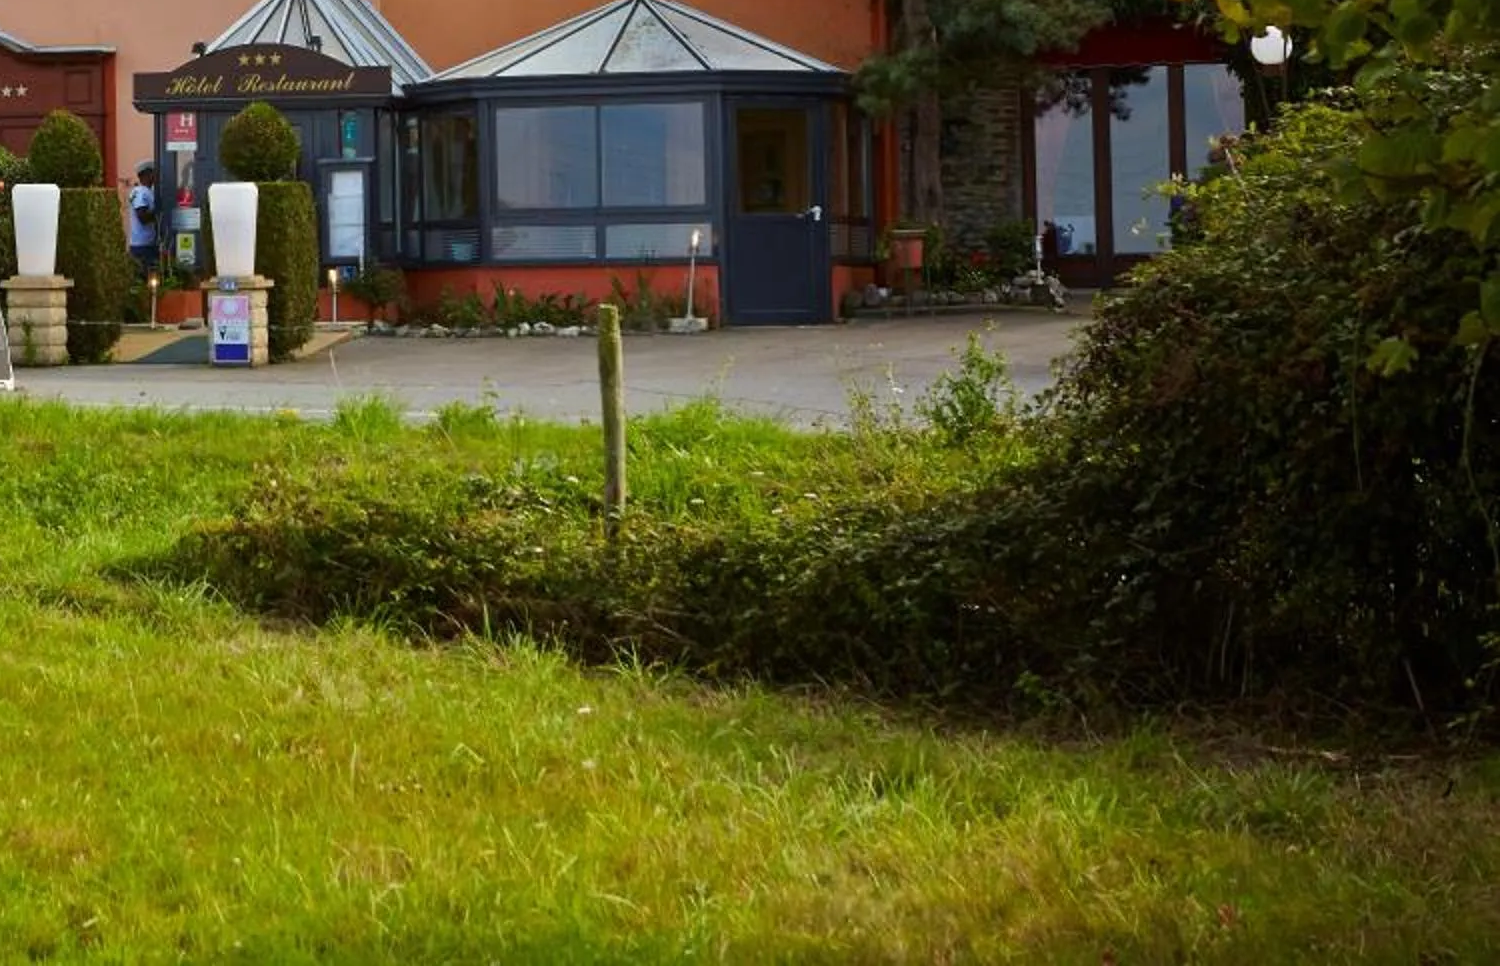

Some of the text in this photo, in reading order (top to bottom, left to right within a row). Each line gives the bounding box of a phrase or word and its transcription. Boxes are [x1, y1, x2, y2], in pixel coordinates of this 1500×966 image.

[165, 71, 356, 95] Hôtel Restaurant
[179, 112, 194, 128] H
